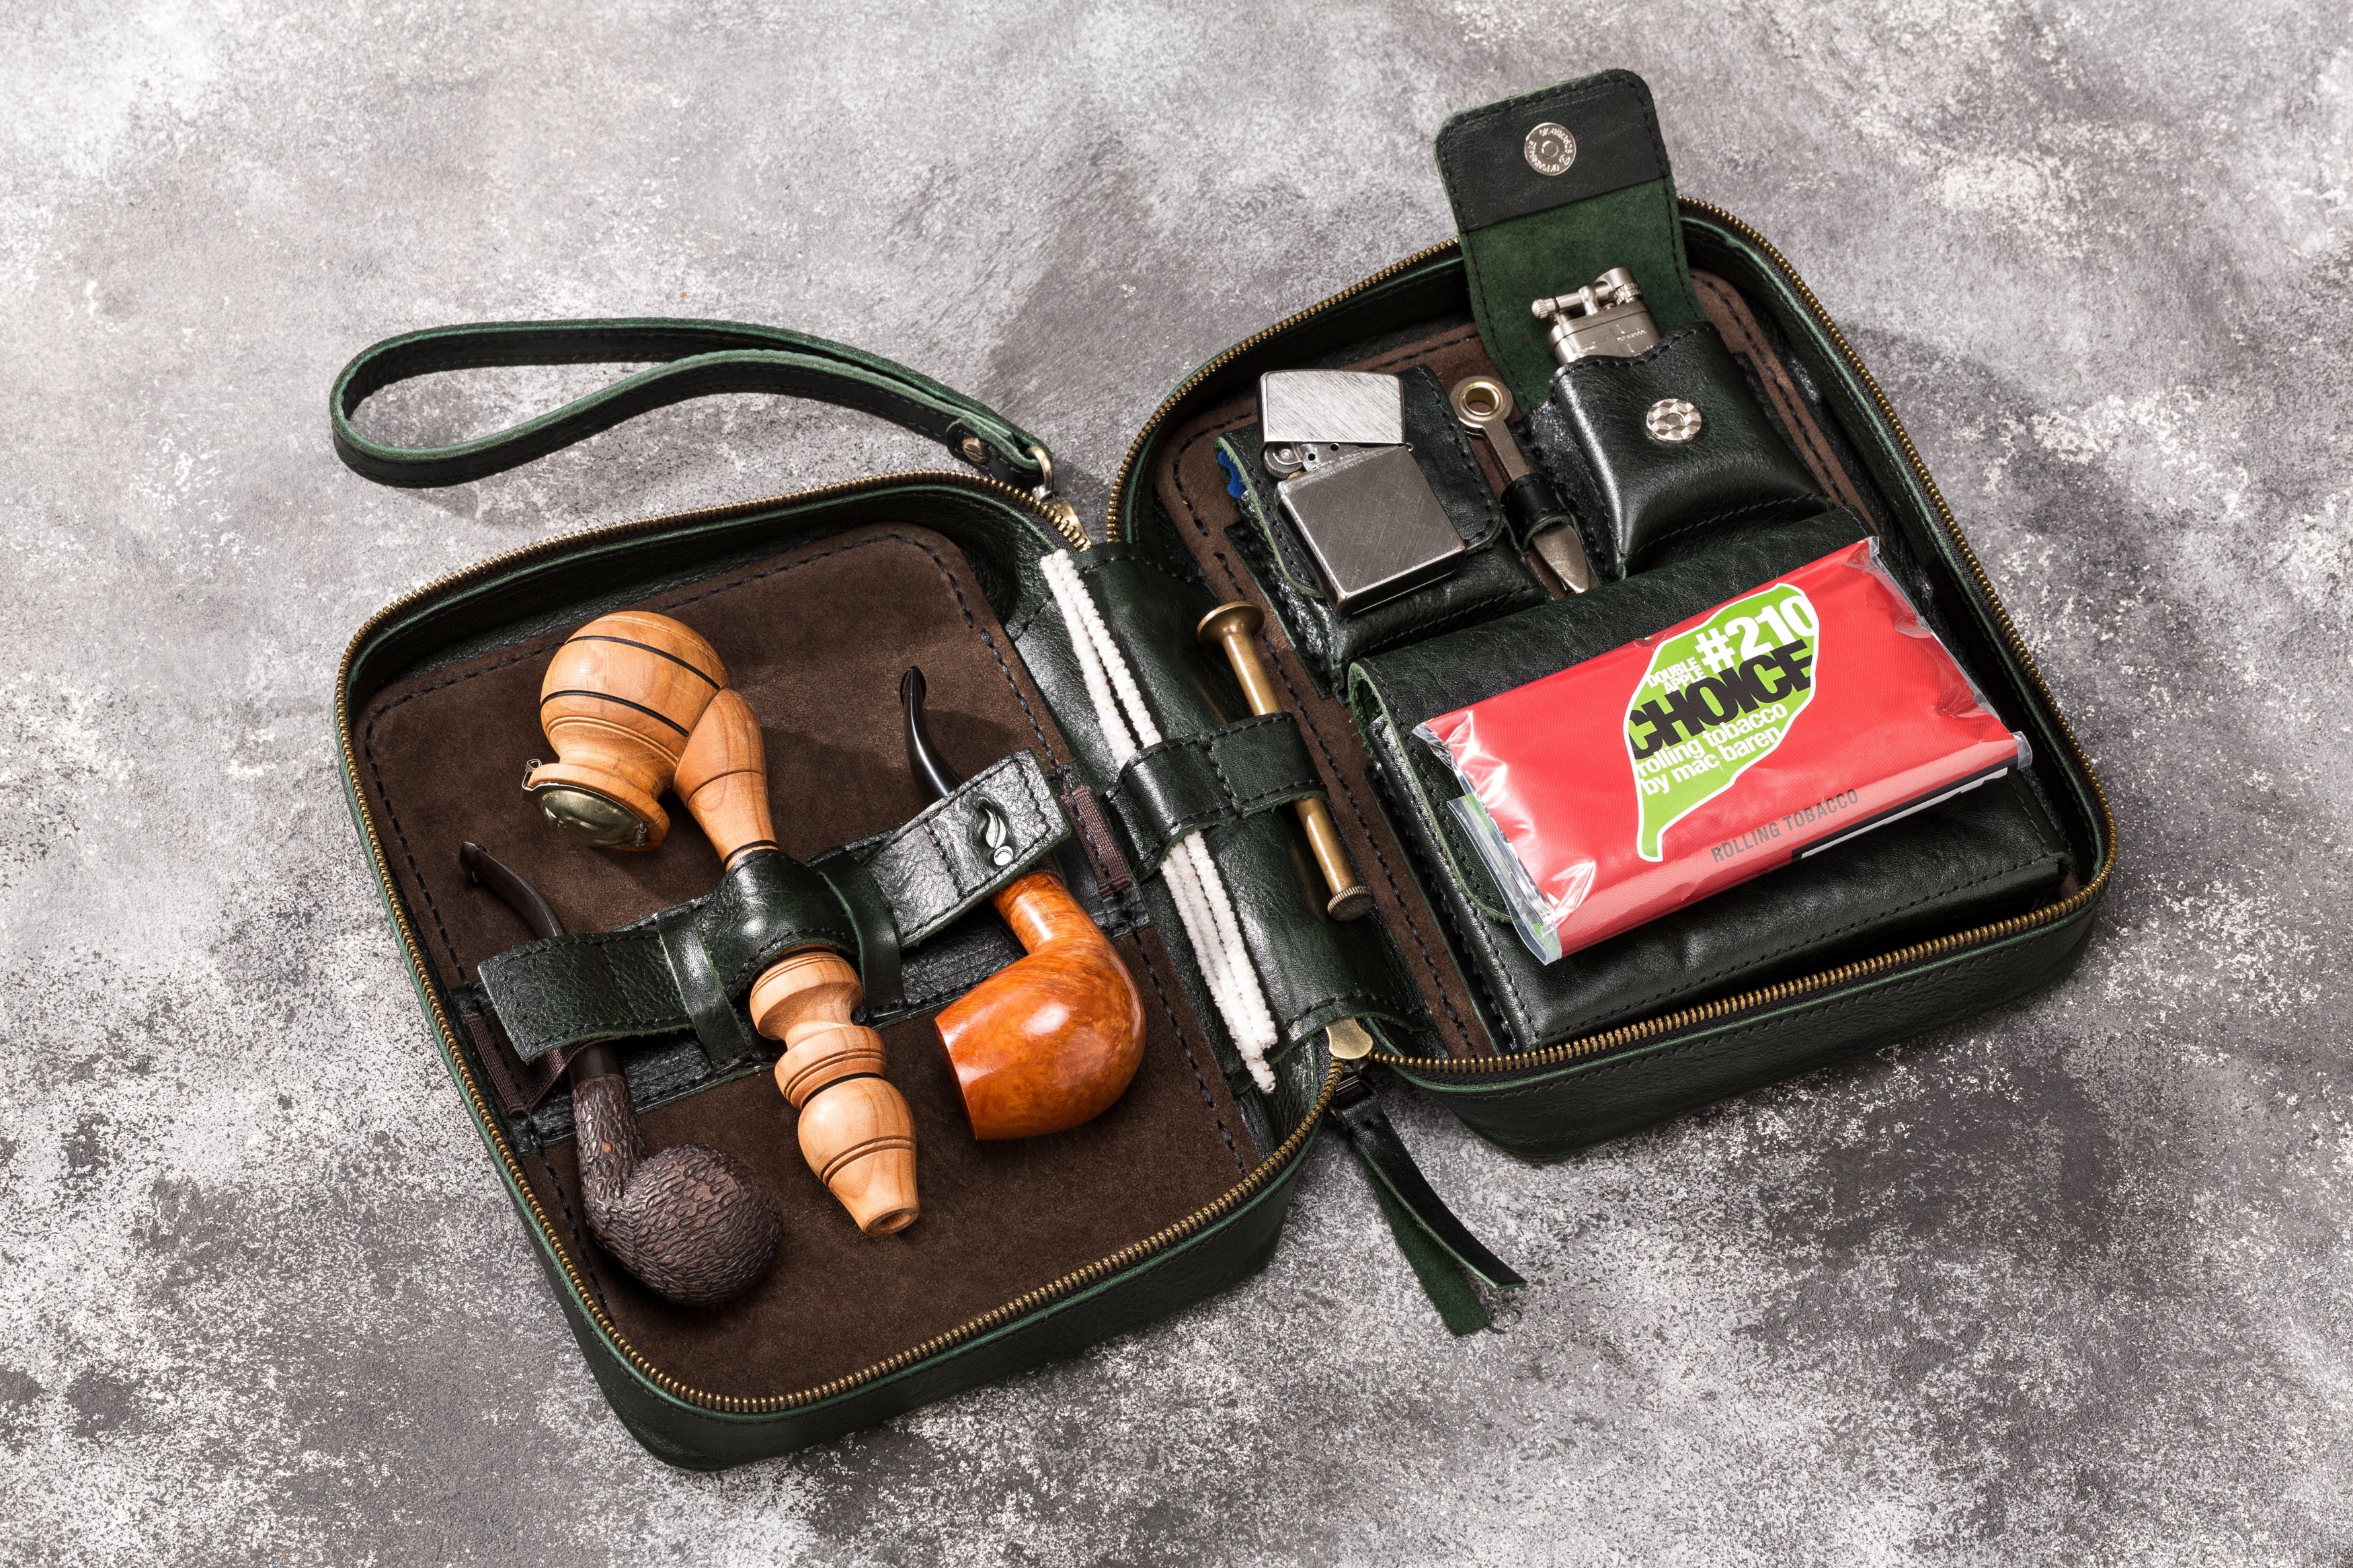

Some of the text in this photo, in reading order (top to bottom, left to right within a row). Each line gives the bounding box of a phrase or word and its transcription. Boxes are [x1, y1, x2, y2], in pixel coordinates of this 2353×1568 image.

[1695, 595, 1817, 673] #210
[1628, 638, 1814, 760] CHOICE
[1646, 657, 1701, 688] DOUBLE
[1663, 667, 1708, 695] APPLE
[1636, 703, 1788, 778] rolling tobacco
[1639, 727, 1782, 796] by mac baren
[1710, 788, 1859, 863] ROLLING TOBACCO
